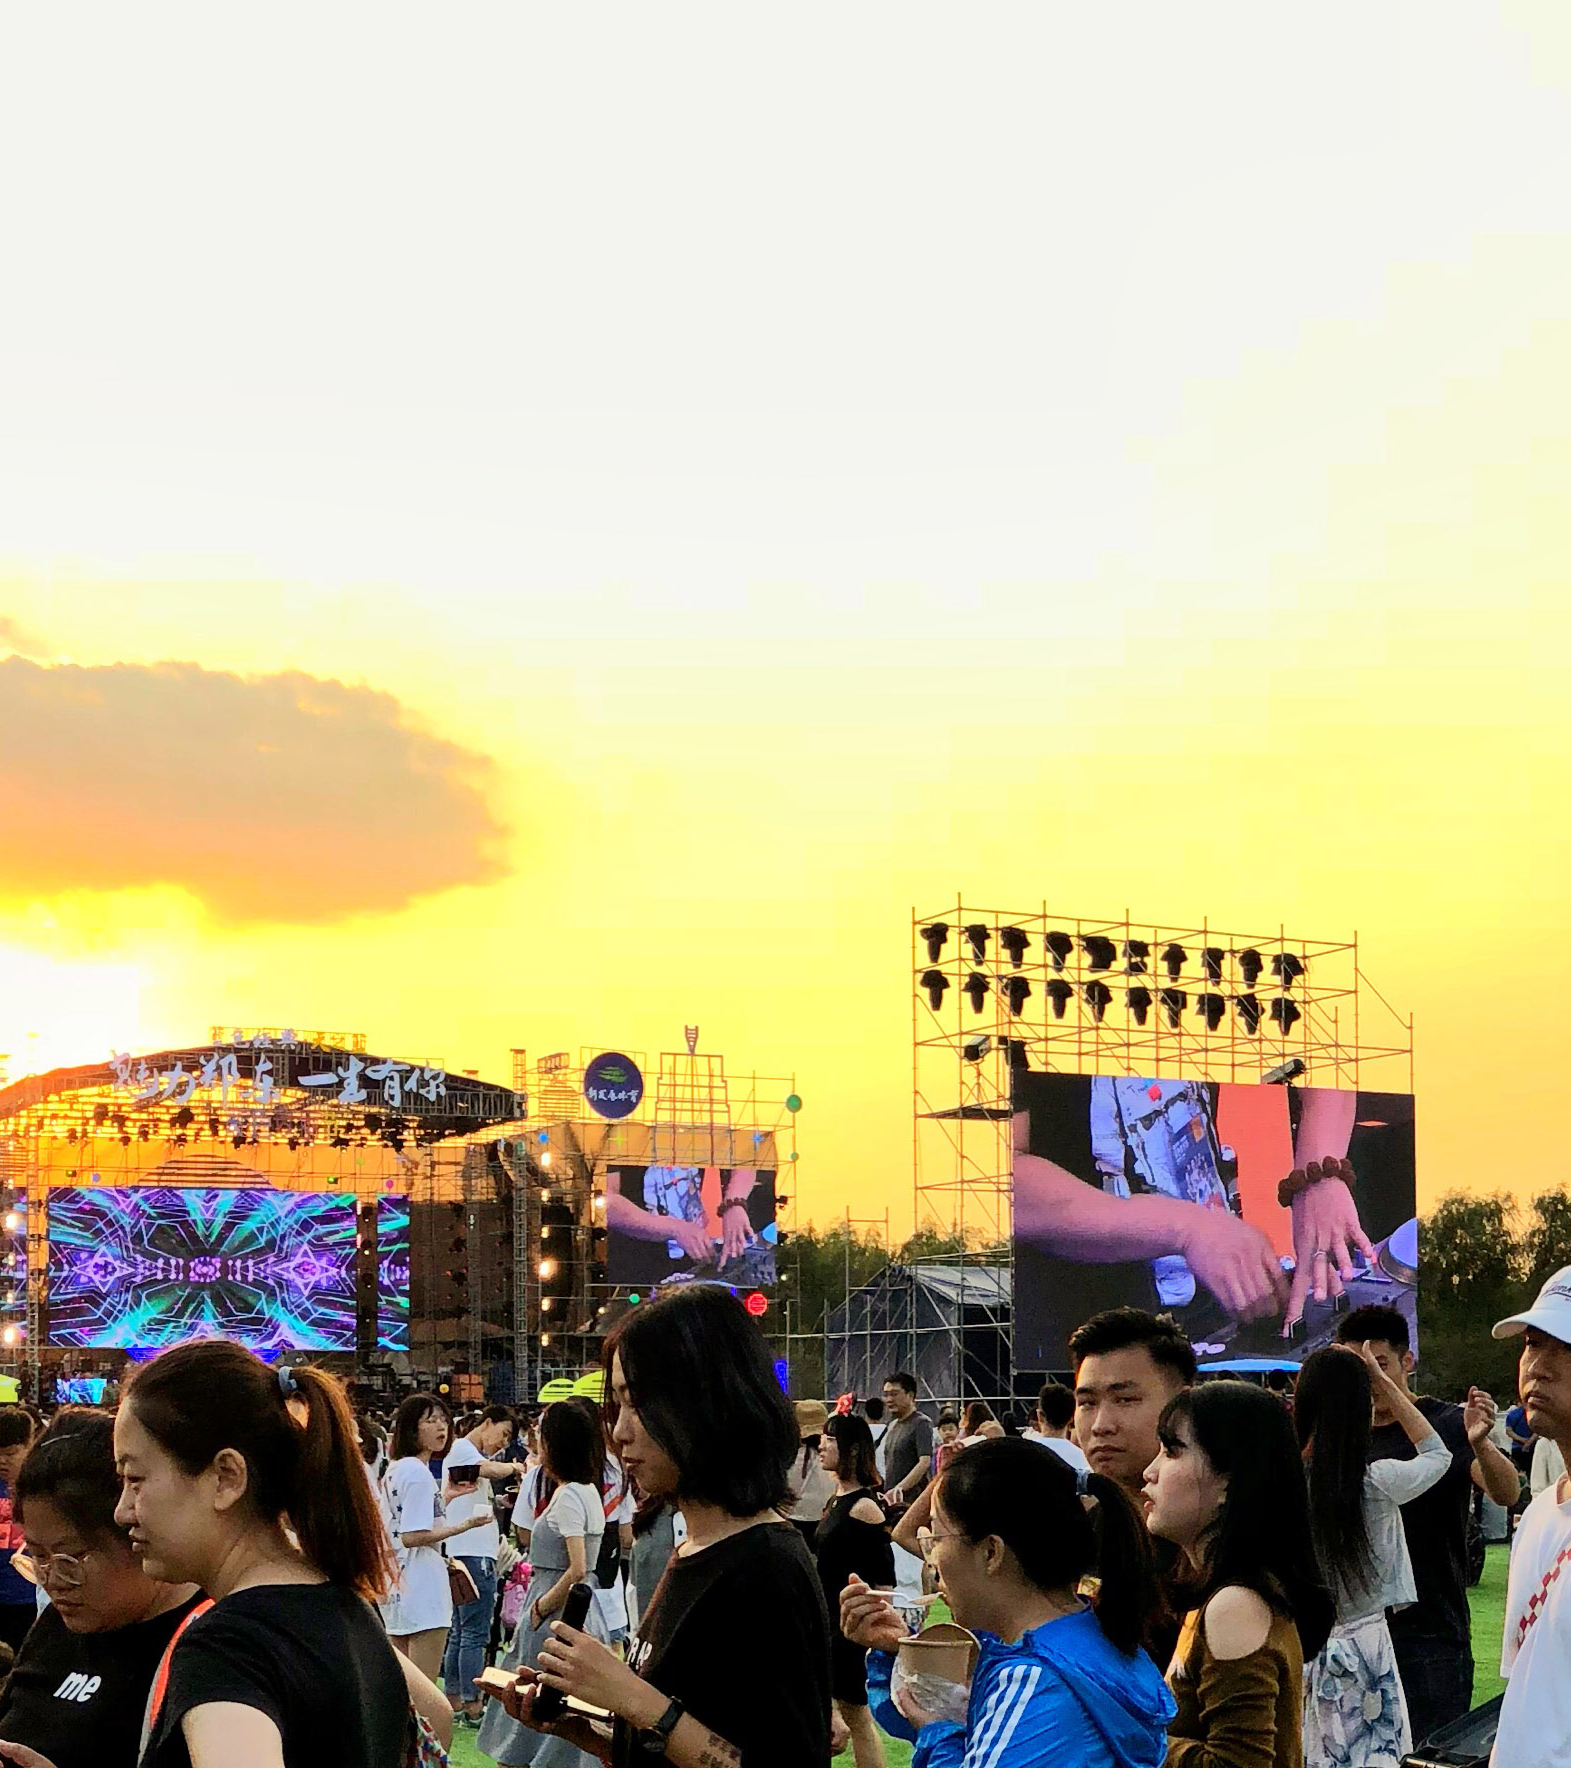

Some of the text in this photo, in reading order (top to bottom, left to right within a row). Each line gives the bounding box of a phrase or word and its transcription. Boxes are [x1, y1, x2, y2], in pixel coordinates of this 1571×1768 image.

[111, 1050, 447, 1107] 魅力郑东 一生有你
[53, 1672, 102, 1702] me
